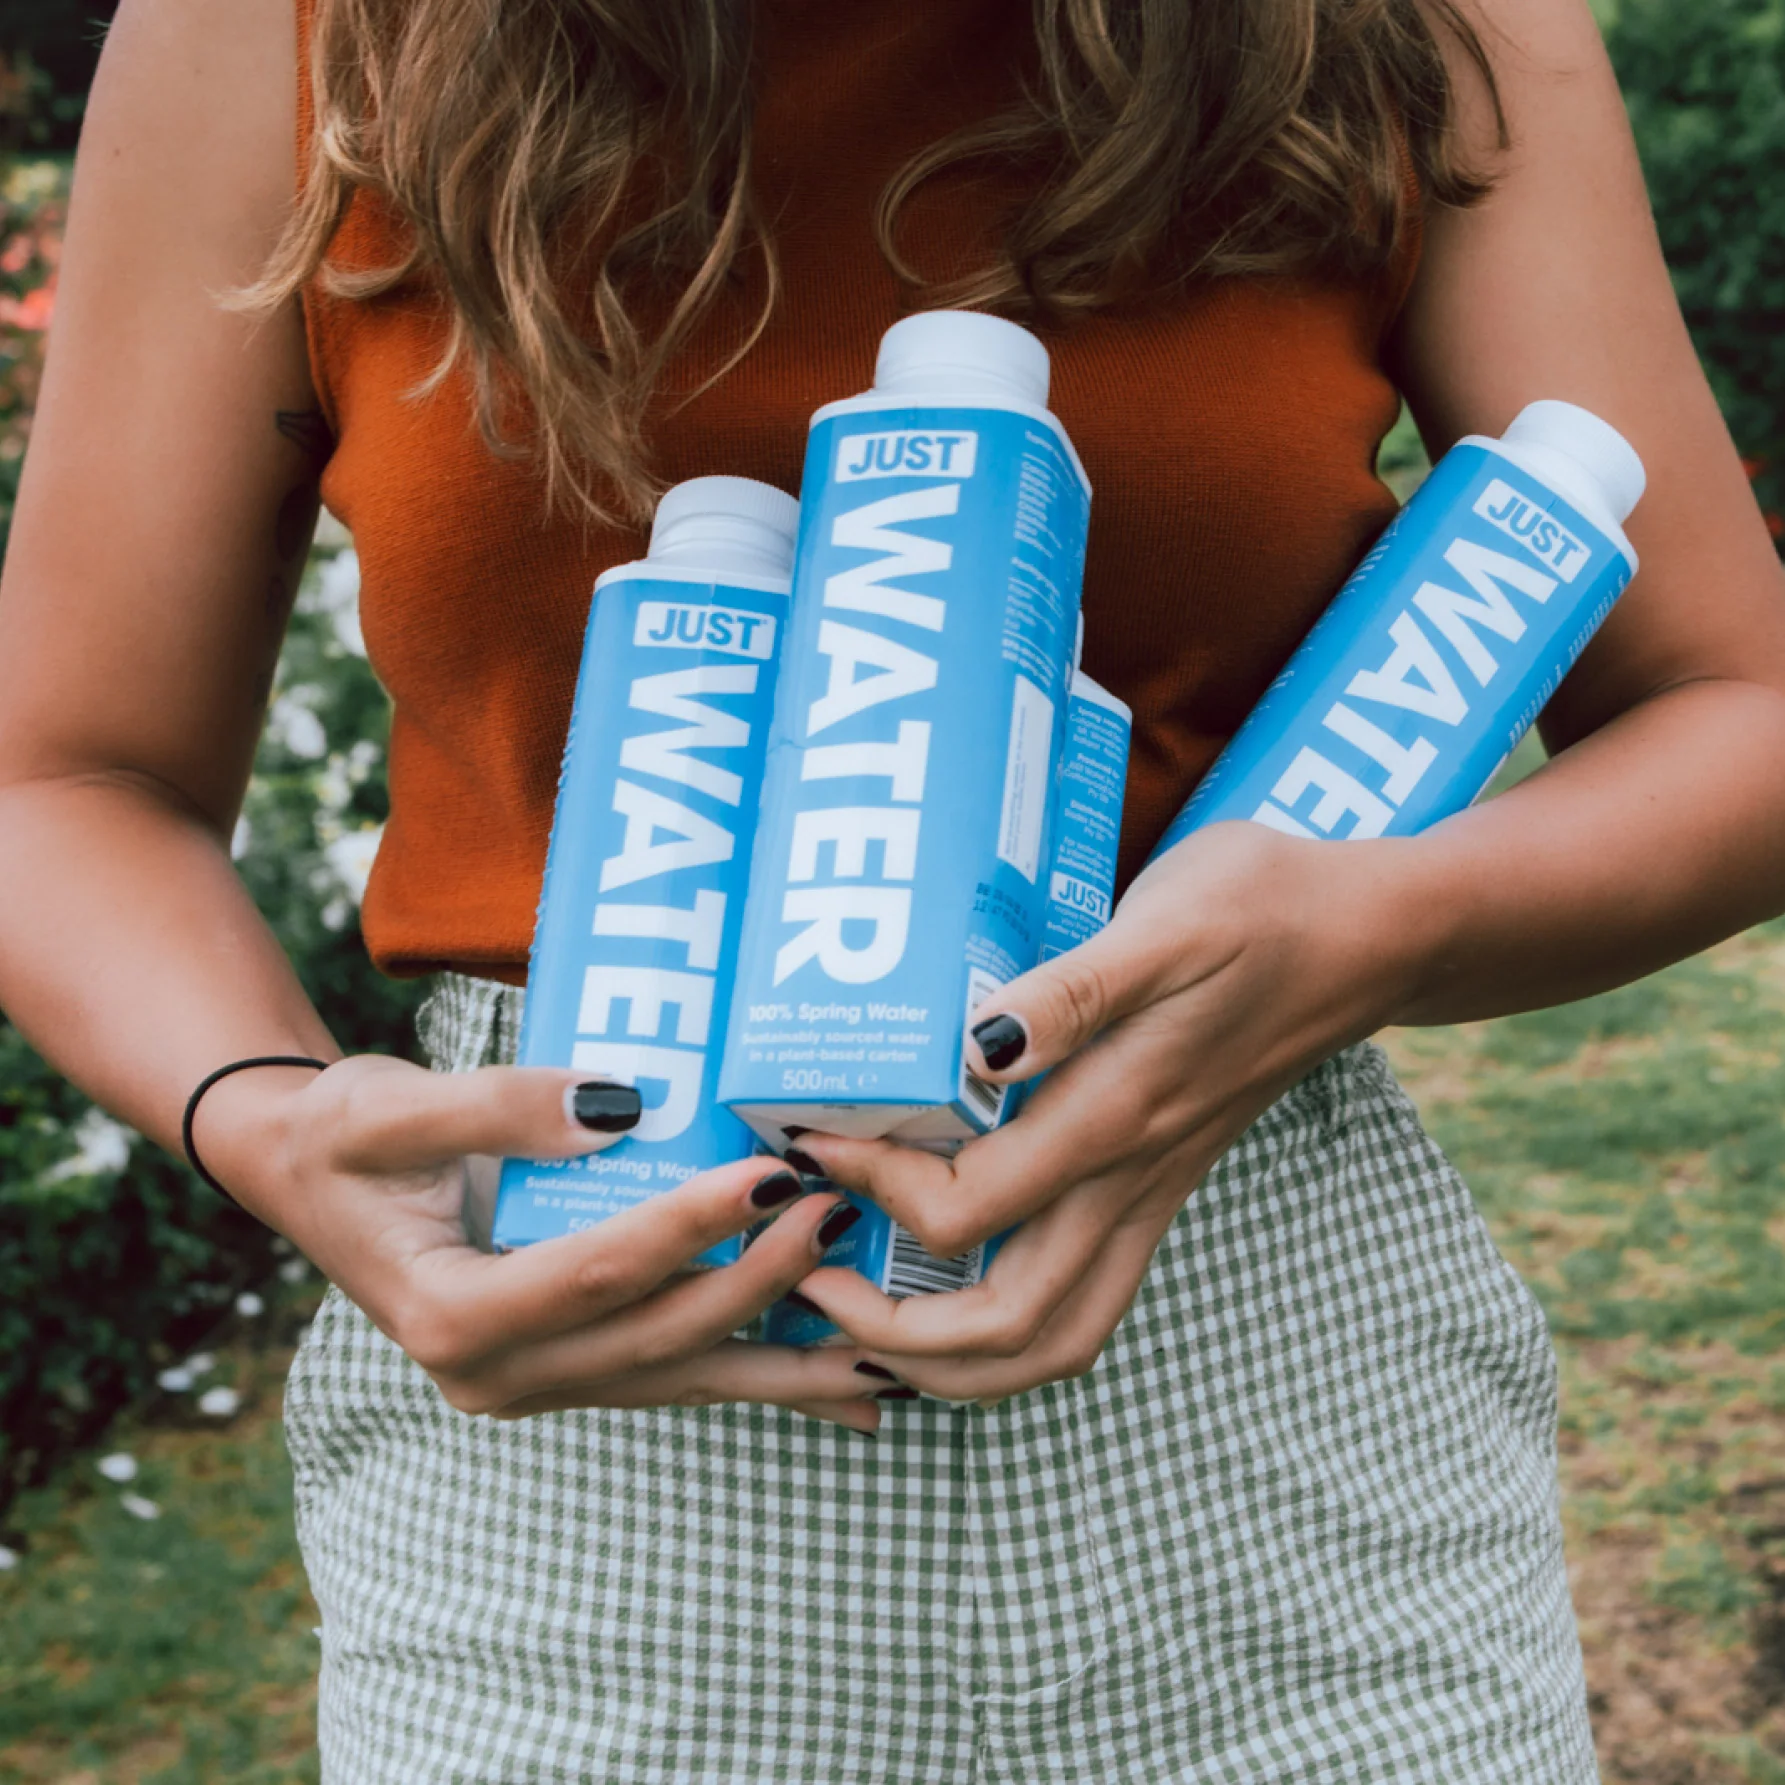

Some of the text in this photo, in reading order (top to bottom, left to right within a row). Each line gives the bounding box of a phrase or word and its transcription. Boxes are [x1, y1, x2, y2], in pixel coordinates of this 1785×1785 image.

[849, 435, 961, 475] JUST
[1487, 496, 1584, 567] JUST
[648, 608, 763, 650] JUST
[773, 484, 960, 988] WATER
[1058, 879, 1108, 918] JUST
[749, 1003, 929, 1025] 100% Spring Water
[825, 1031, 884, 1044] sourced
[888, 1032, 931, 1045] water
[778, 1048, 866, 1063] plant-based
[868, 1050, 918, 1063] carton
[587, 1155, 652, 1181] Spring
[657, 1161, 705, 1181] Wat
[525, 1176, 611, 1197] Sustainably
